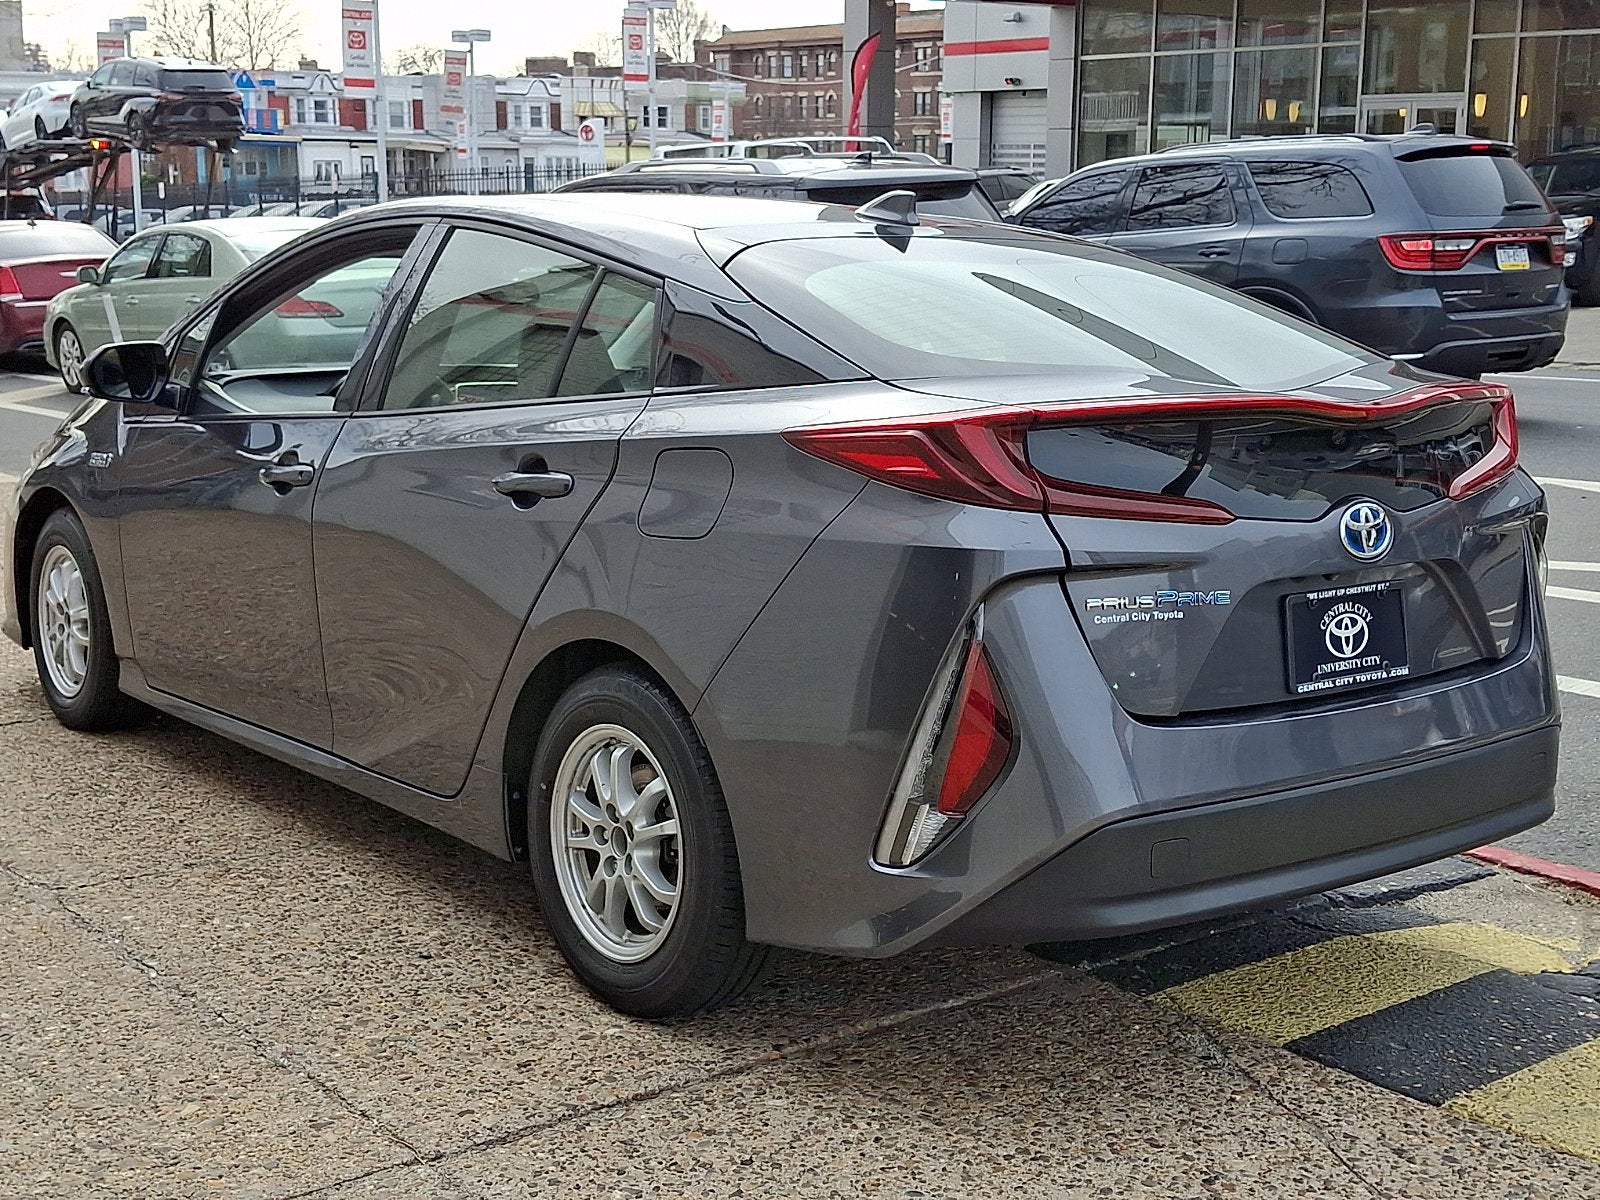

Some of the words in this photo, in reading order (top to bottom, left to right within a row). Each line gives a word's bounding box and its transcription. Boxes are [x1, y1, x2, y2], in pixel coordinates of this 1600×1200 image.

[1085, 595, 1155, 611] PRIUS
[1155, 590, 1231, 608] PRIME
[1319, 590, 1336, 599] LIGHT
[1337, 588, 1345, 596] UP
[1346, 584, 1376, 595] CHESTNUT
[1094, 612, 1130, 624] Central
[1131, 611, 1151, 622] City
[1152, 610, 1184, 621] Toyota
[1320, 601, 1354, 630] CENTRAL
[1354, 603, 1374, 623] CITY
[1317, 658, 1362, 674] UNIVERSITY
[1362, 655, 1381, 667] CITY
[1297, 682, 1335, 693] CENTRAL
[1335, 676, 1354, 686] CITY
[1355, 671, 1388, 683] TOYOTA
